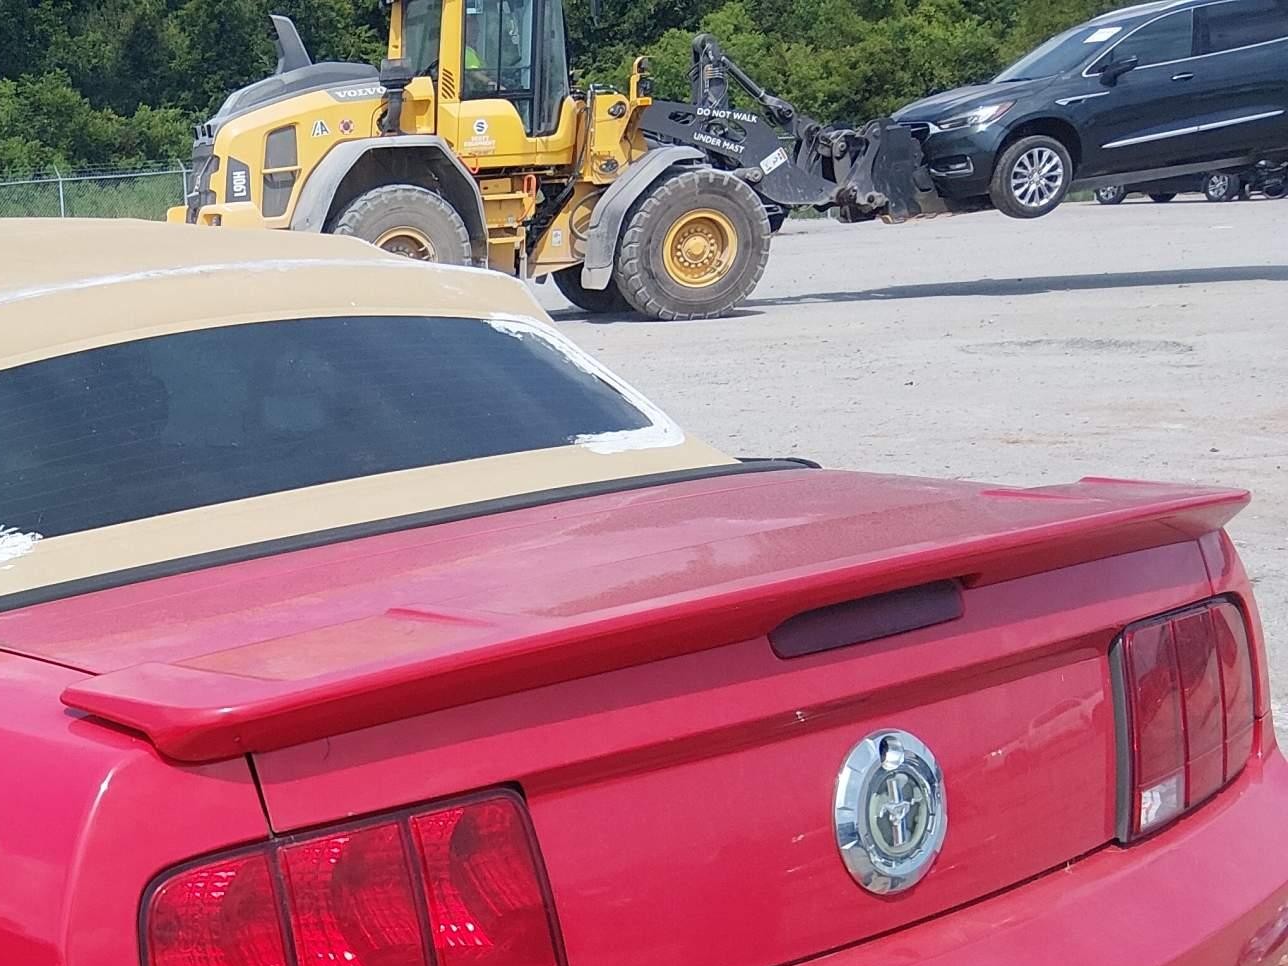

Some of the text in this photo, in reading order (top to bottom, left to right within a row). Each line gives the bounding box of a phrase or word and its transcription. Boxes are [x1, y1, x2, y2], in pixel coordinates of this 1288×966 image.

[335, 85, 387, 98] VOLVO
[697, 108, 758, 123] DO NOT WALK
[693, 132, 745, 153] UNDER MAST
[232, 170, 247, 197] L90H
